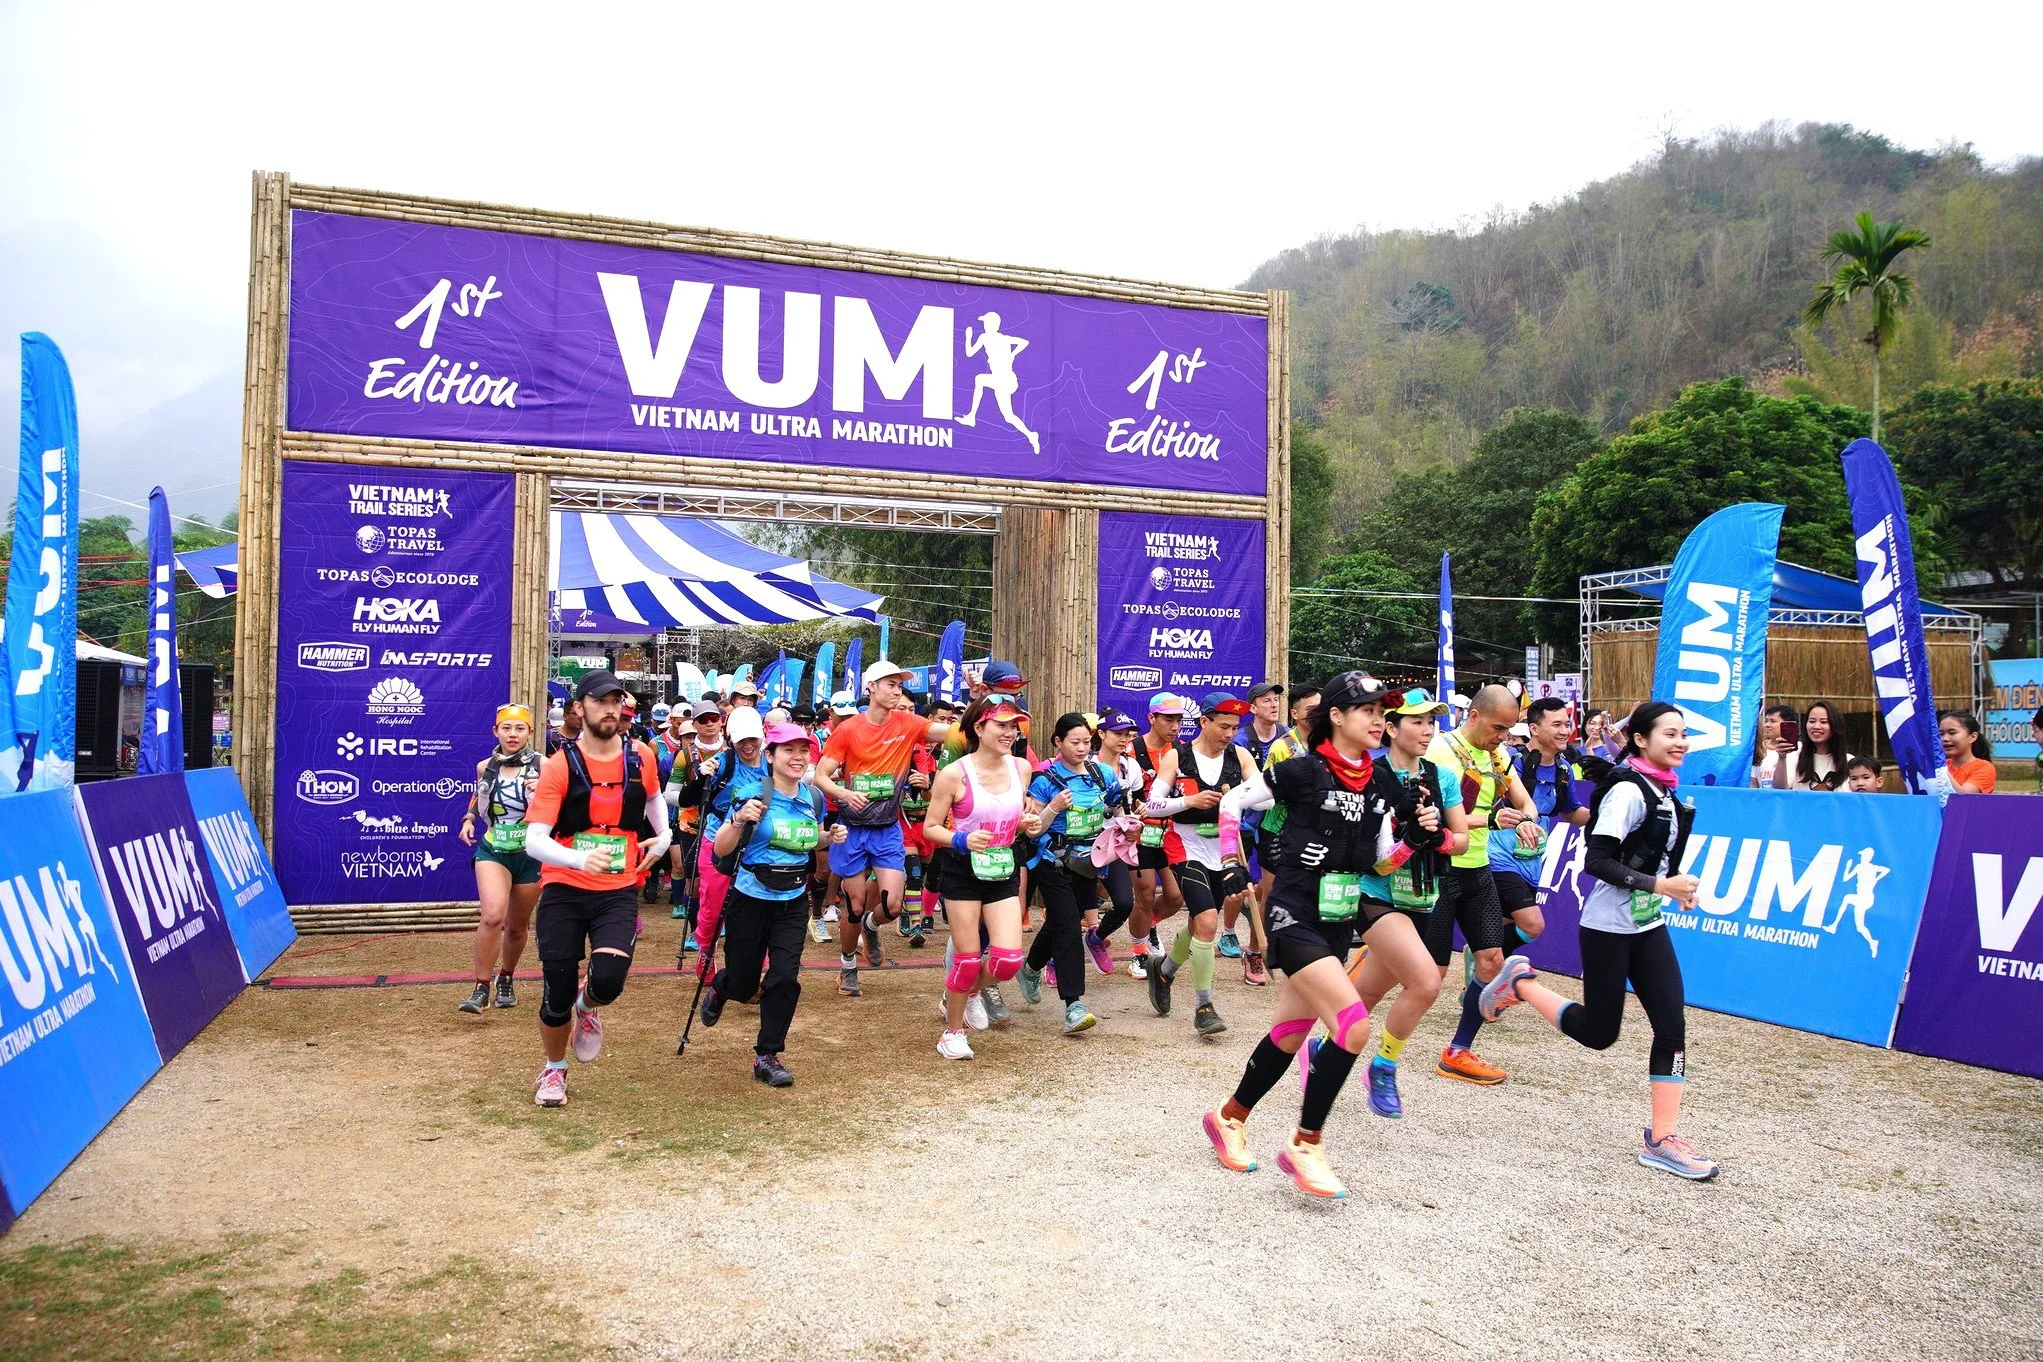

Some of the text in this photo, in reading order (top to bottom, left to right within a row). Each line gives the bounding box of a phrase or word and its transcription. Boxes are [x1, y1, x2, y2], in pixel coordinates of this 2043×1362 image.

[395, 275, 502, 349] 1st
[596, 271, 955, 420] VUM
[363, 354, 518, 409] Edition
[1126, 347, 1207, 411] 1st
[630, 403, 954, 449] VIETNAM ULTRA MARATHON
[1105, 414, 1221, 462] Edition
[348, 484, 434, 504] VIETNAM
[348, 500, 434, 518] TRAIL SERIES
[387, 526, 437, 539] TOPAS
[1145, 532, 1207, 549] VIETNAM
[387, 538, 445, 551] TRAVEL
[1885, 513, 1902, 588] MARATHON
[1145, 546, 1207, 561] TRAIL SERIES
[317, 569, 479, 586] TOPAS ECOLODGE
[1174, 568, 1209, 578] TOPAS
[1173, 578, 1215, 589] TRAVEL
[353, 597, 442, 622] HOKA
[1123, 604, 1241, 618] TOPAS ECOLODGE
[352, 623, 441, 634] FLY HUMAN FLY
[1856, 519, 1915, 739] VUM
[1150, 627, 1214, 649] HOKA
[302, 647, 366, 661] HAMMER
[1149, 650, 1213, 660] FLY HUMAN FLY
[1113, 670, 1160, 681] HAMMER
[1673, 582, 1739, 754] VUM
[1730, 590, 1750, 747] VIETNAM ULTRA MARATHON
[376, 716, 414, 727] Hospital
[2012, 722, 2036, 742] QUE
[370, 739, 418, 755] IRC
[302, 779, 353, 793] THOM
[372, 780, 477, 795] Operation Smi
[385, 822, 448, 838] blue dragon
[197, 811, 259, 891] VUM
[341, 846, 423, 863] newborns
[342, 863, 423, 878] VIETNAM
[109, 828, 200, 941] VUM
[1394, 876, 1413, 885] VUM
[1702, 918, 1739, 936] ULTRA
[1743, 924, 1820, 949] MARATHON
[0, 866, 88, 1028] UM
[33, 1005, 64, 1039] ULTRA
[60, 981, 96, 1021] MARATHON
